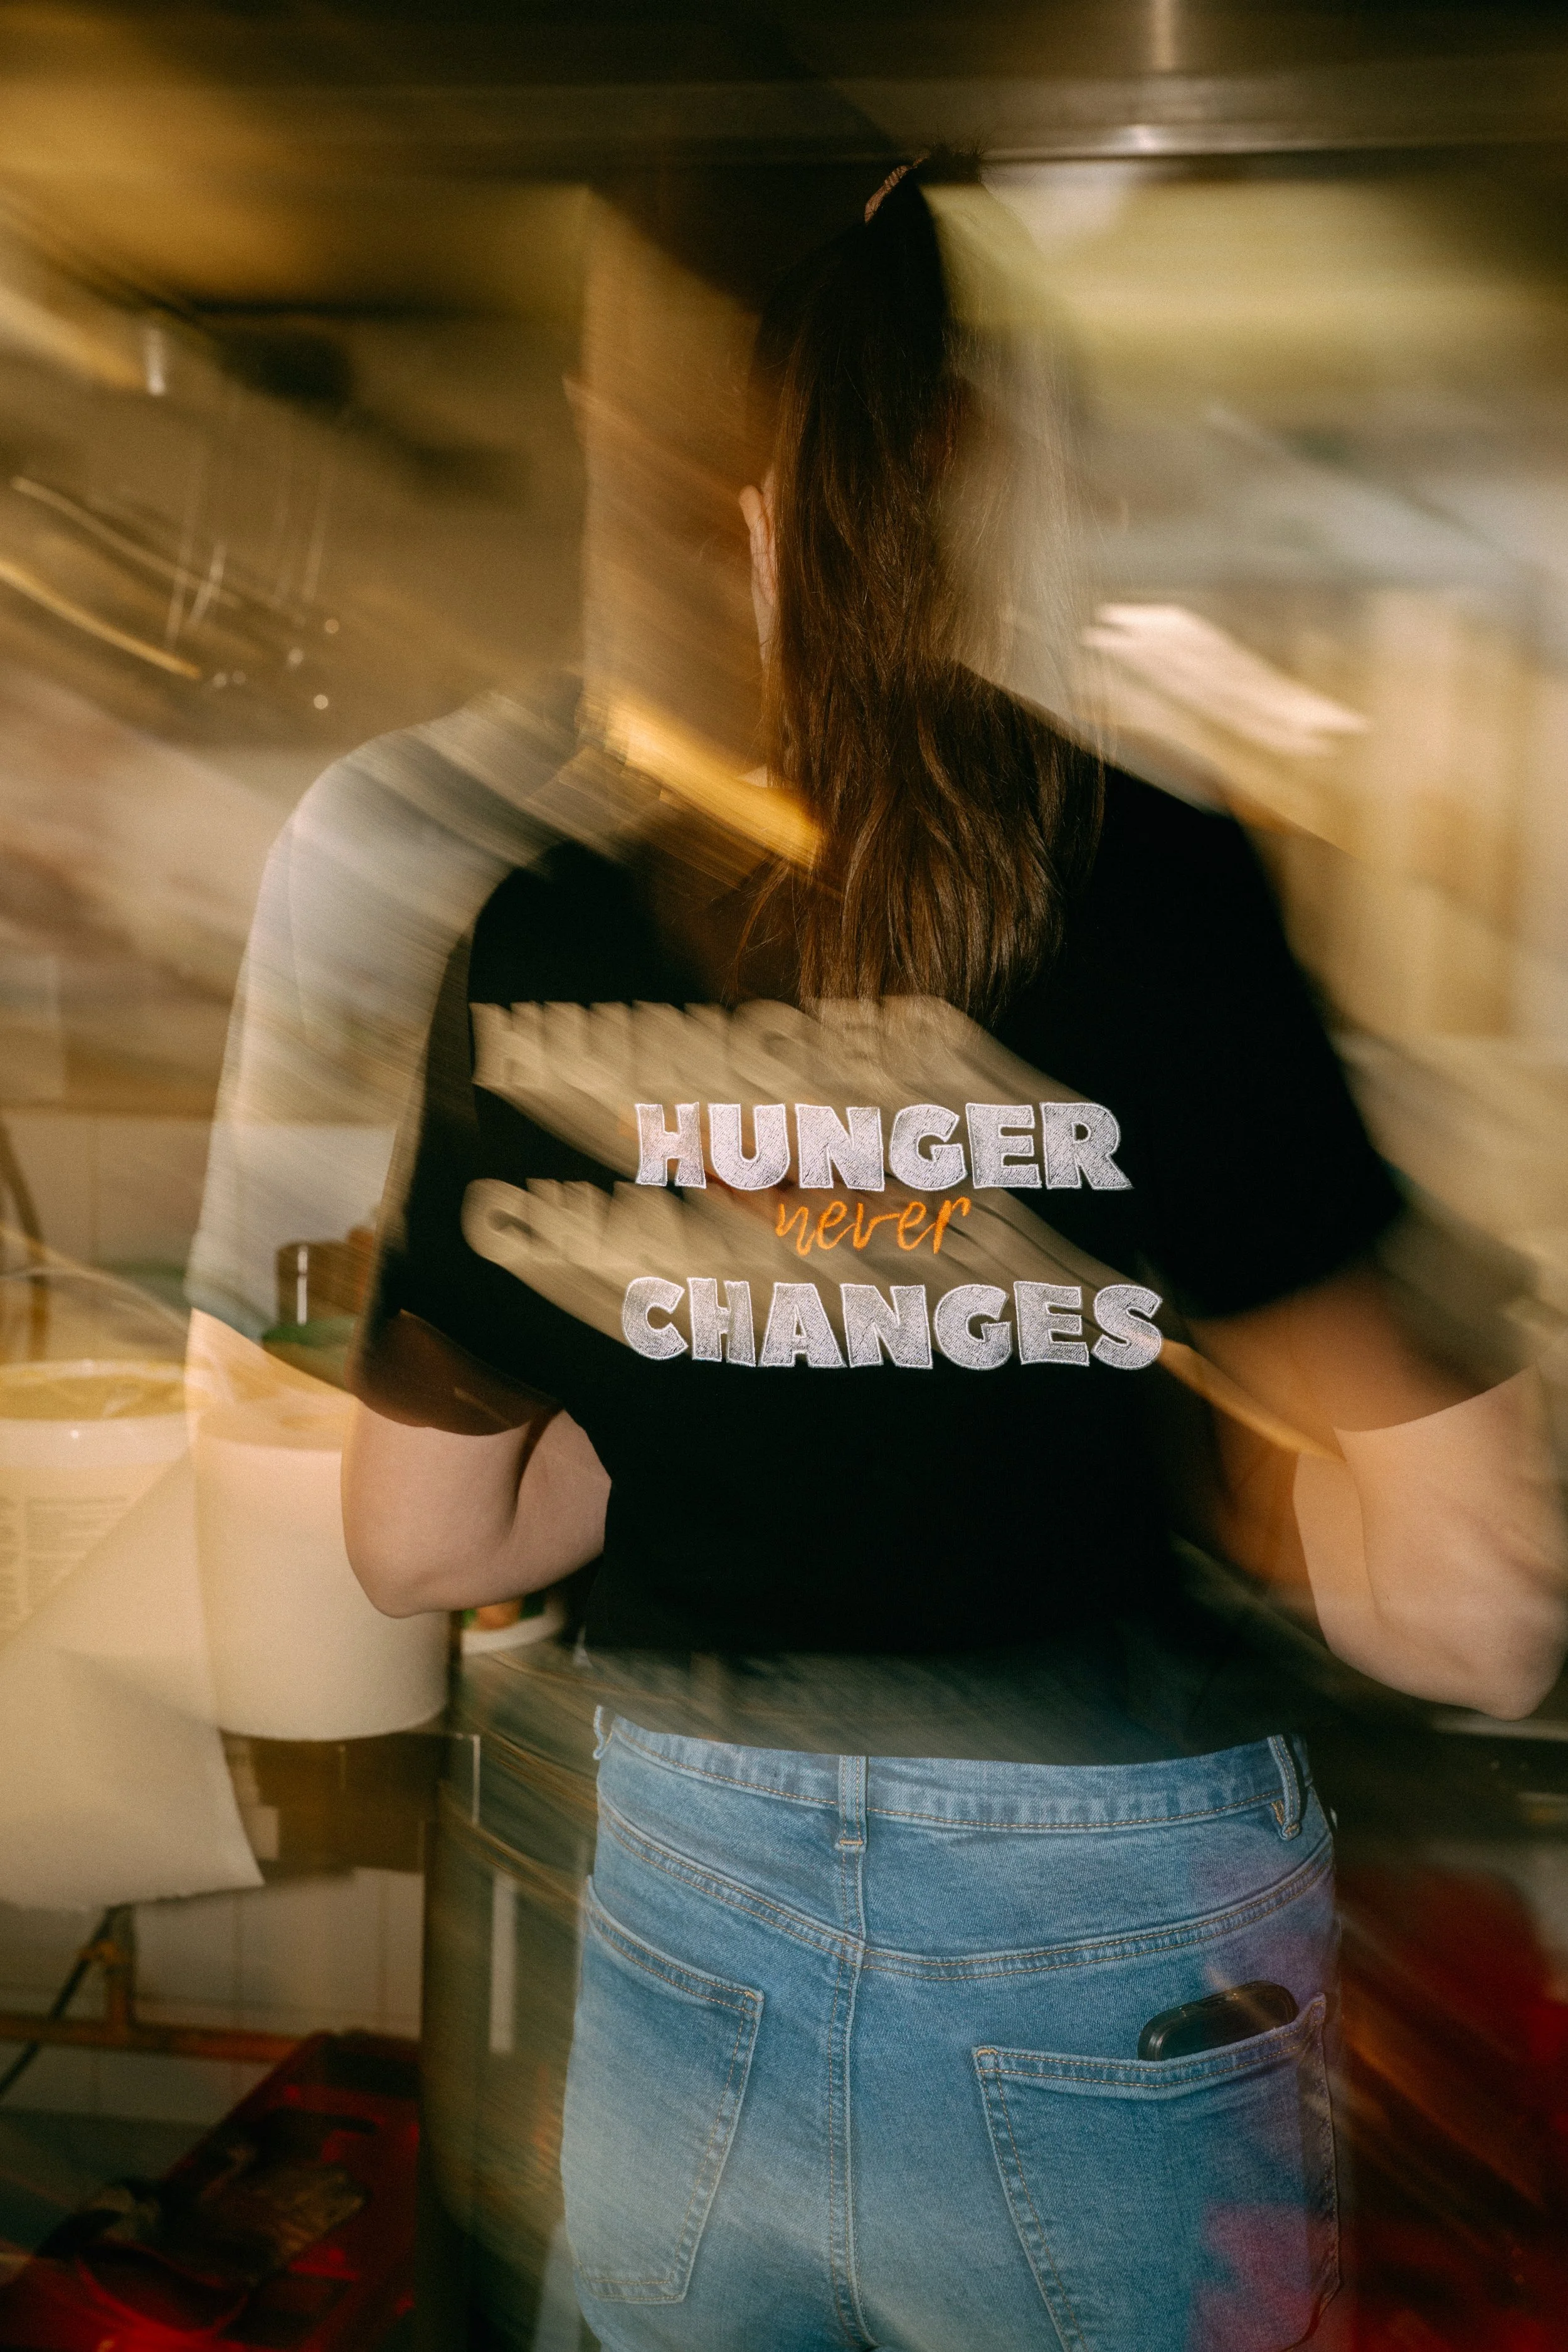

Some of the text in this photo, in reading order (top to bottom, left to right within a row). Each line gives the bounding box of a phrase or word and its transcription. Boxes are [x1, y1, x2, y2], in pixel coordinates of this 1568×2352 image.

[635, 1102, 1133, 1191] HUNGER
[777, 1196, 970, 1254] never
[622, 1276, 1163, 1370] CHANGES
